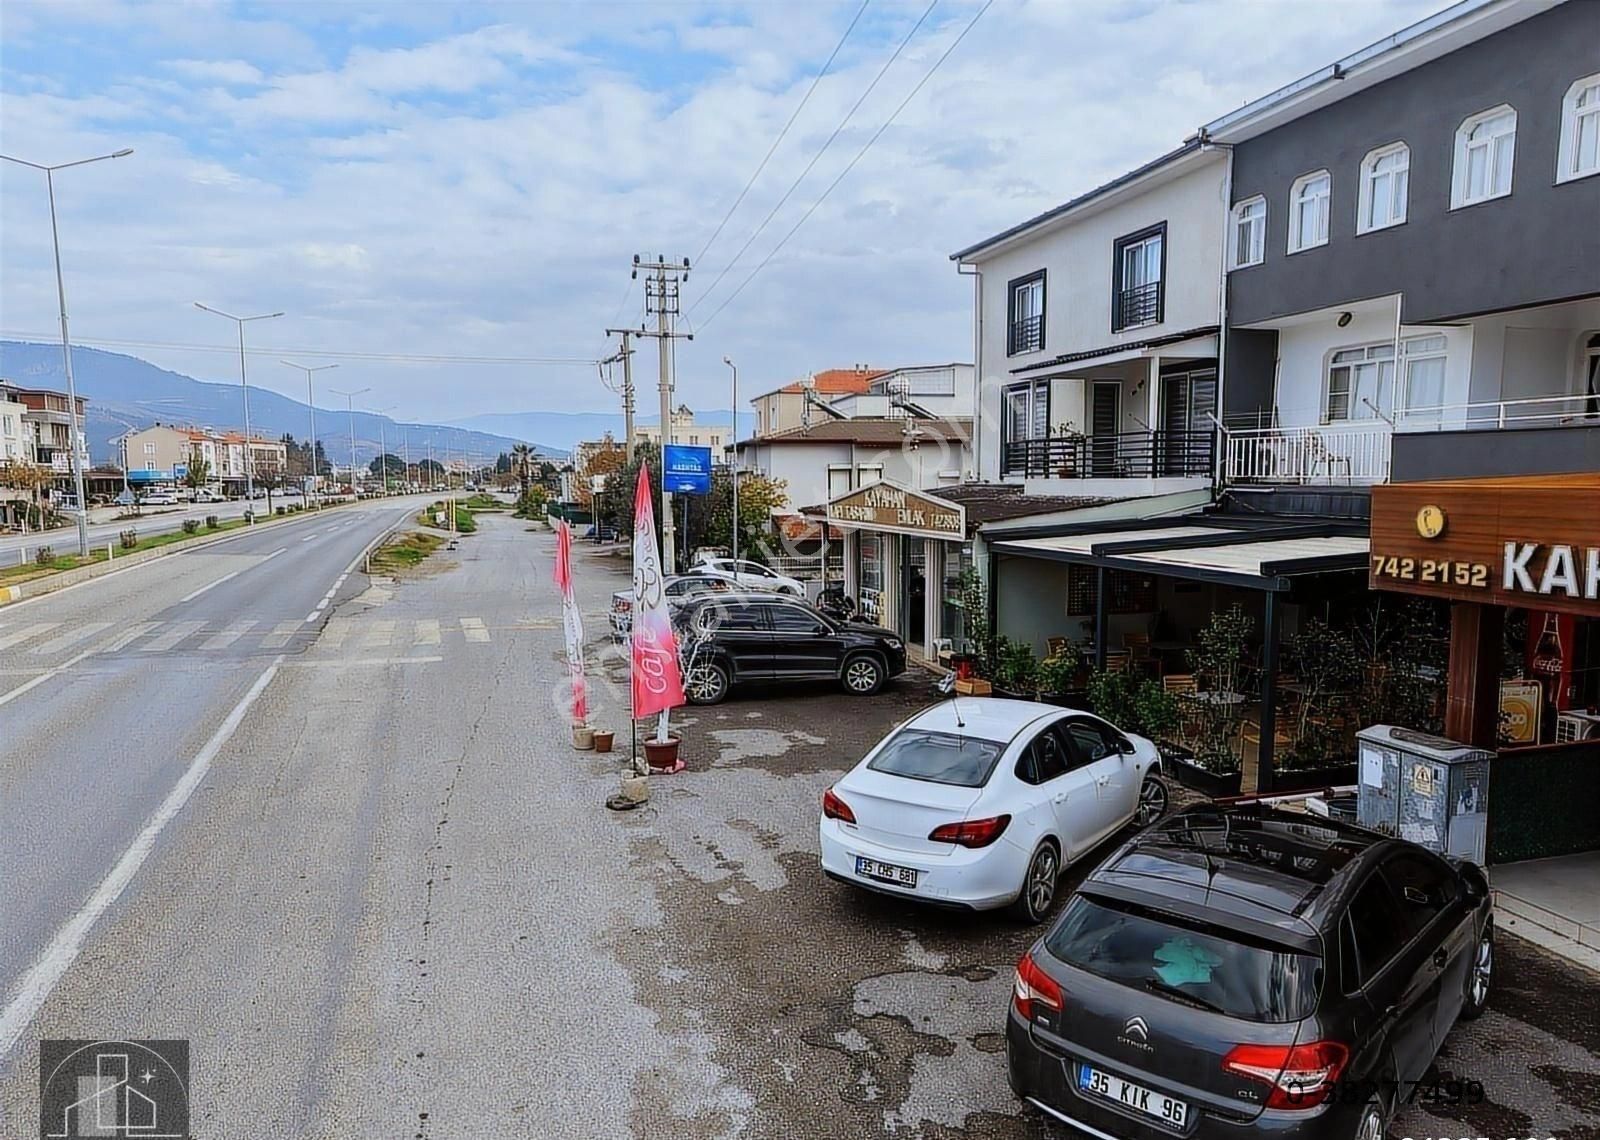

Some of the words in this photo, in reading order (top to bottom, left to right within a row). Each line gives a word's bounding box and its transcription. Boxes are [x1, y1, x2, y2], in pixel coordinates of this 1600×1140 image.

[1373, 556, 1414, 580] 742
[1090, 1071, 1110, 1094] 35
[1120, 1081, 1151, 1110] KIK
[1162, 1100, 1183, 1122] 96
